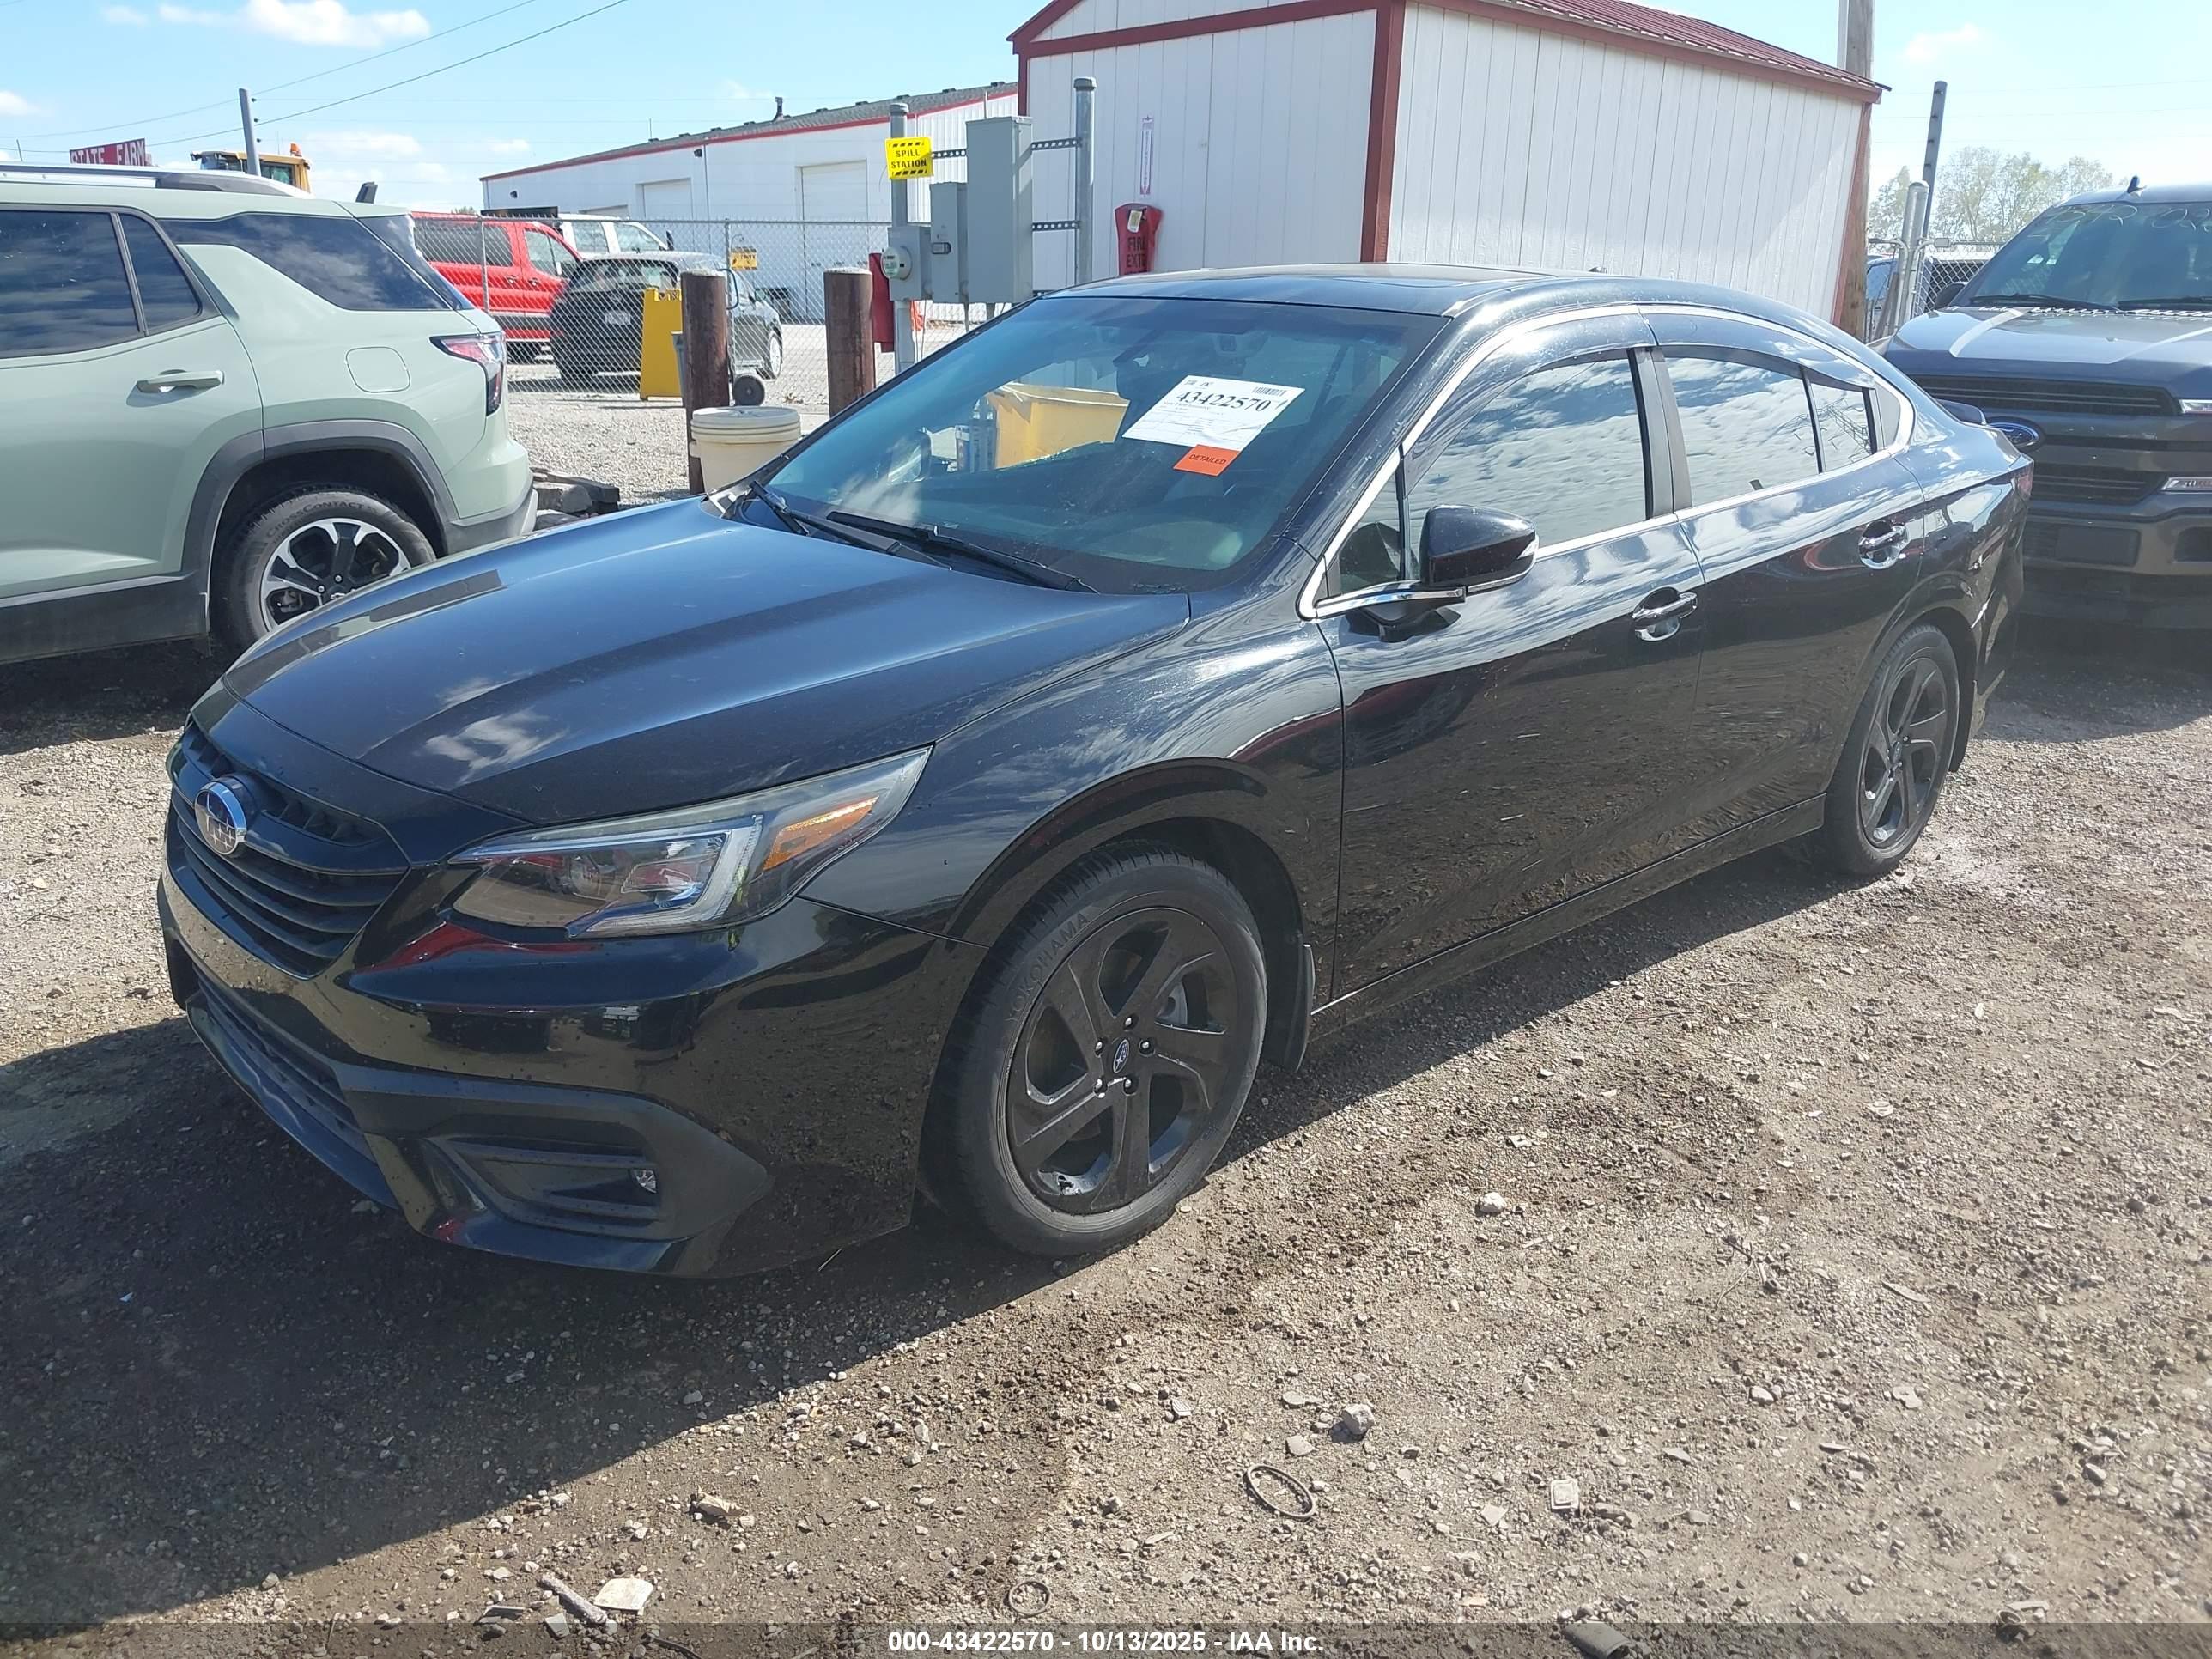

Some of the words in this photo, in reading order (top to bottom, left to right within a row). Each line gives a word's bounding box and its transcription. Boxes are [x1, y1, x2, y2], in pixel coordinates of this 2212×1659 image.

[70, 147, 105, 164] STATE
[117, 140, 144, 166] FARM
[896, 149, 921, 157] SPILL
[890, 158, 927, 169] STATION
[1176, 391, 1273, 412] 43422570
[1188, 453, 1227, 465] DETAILED
[1004, 912, 1091, 1022] YOKOHAMA
